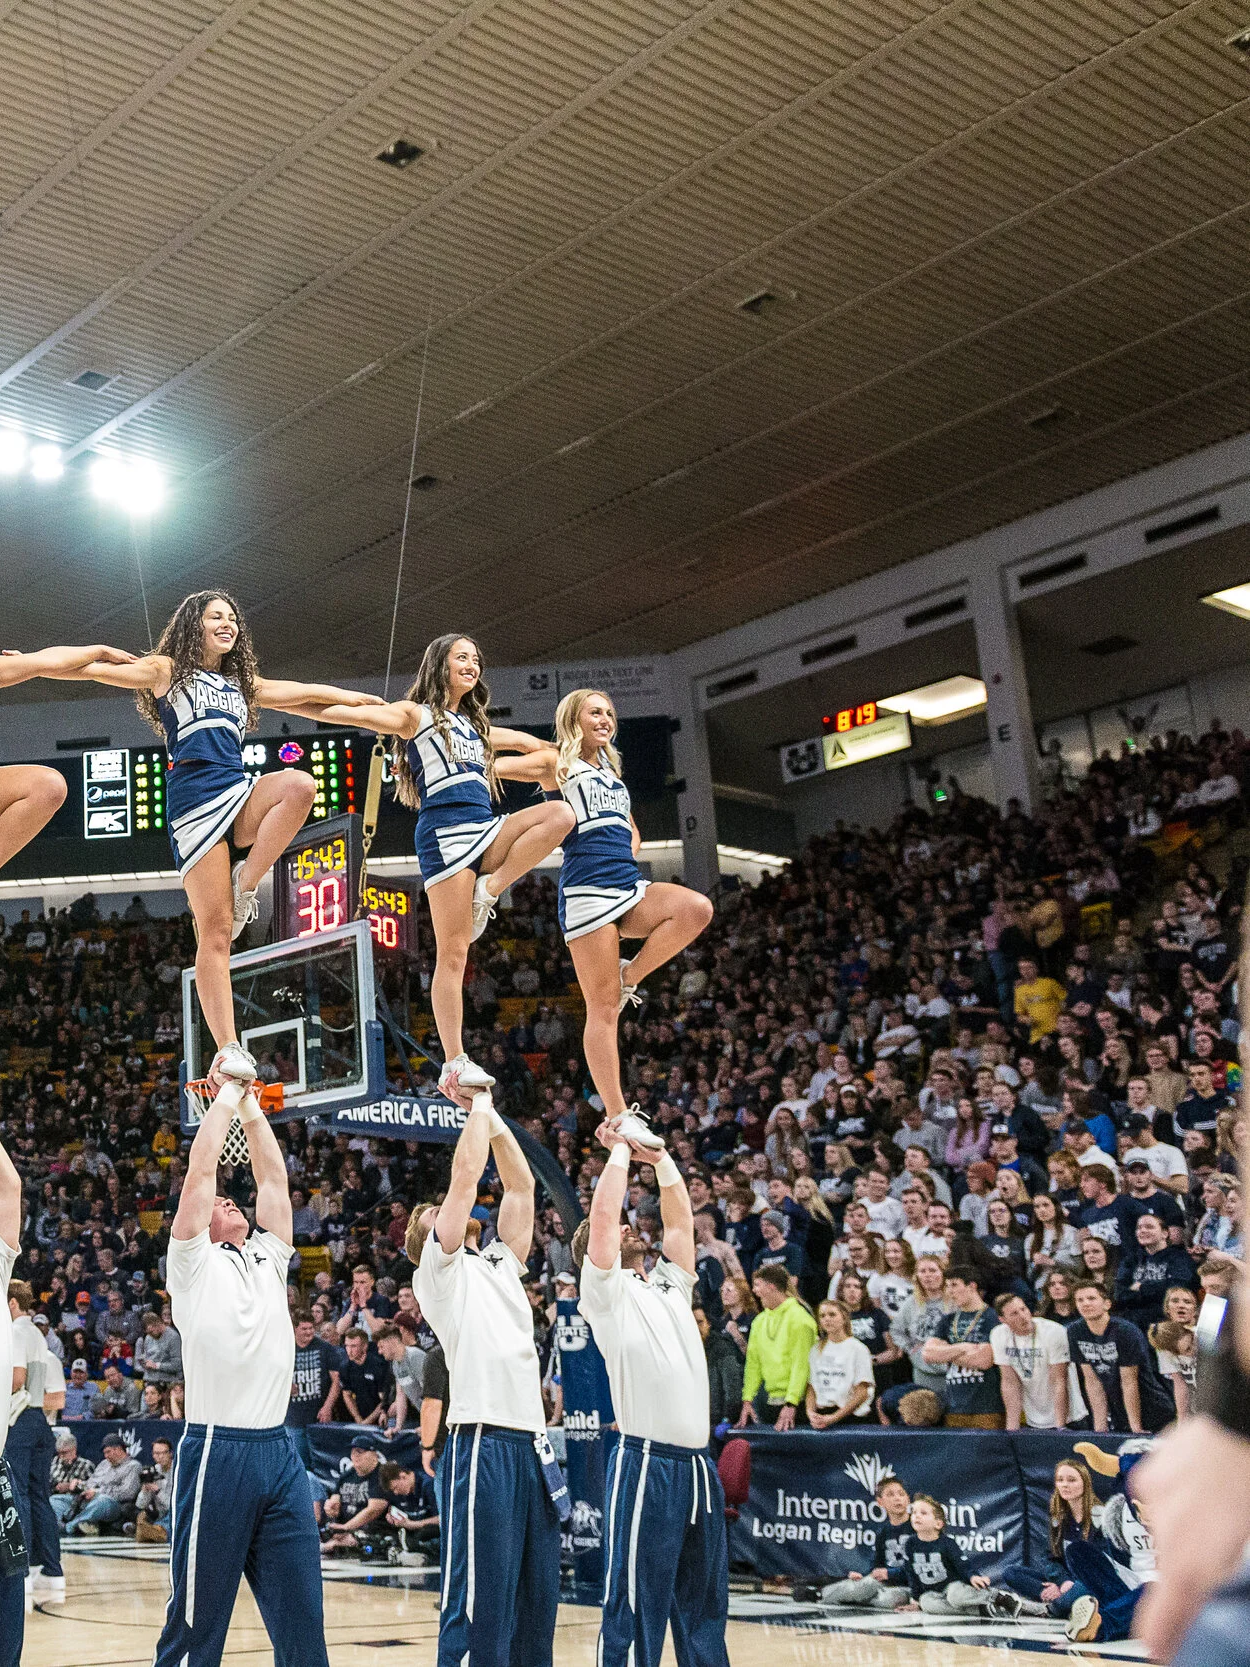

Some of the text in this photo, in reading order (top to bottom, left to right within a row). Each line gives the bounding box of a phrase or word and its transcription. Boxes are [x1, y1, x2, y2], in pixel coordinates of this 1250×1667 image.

[997, 723, 1011, 741] E
[448, 729, 489, 767] AGGIE
[297, 839, 346, 880] 15:43
[297, 876, 340, 941] 30
[363, 887, 408, 916] 15:43
[337, 1100, 470, 1129] AMERICA FIRS
[298, 1381, 321, 1397] LUE
[752, 1517, 812, 1544] Logan
[817, 1521, 877, 1550] Regio
